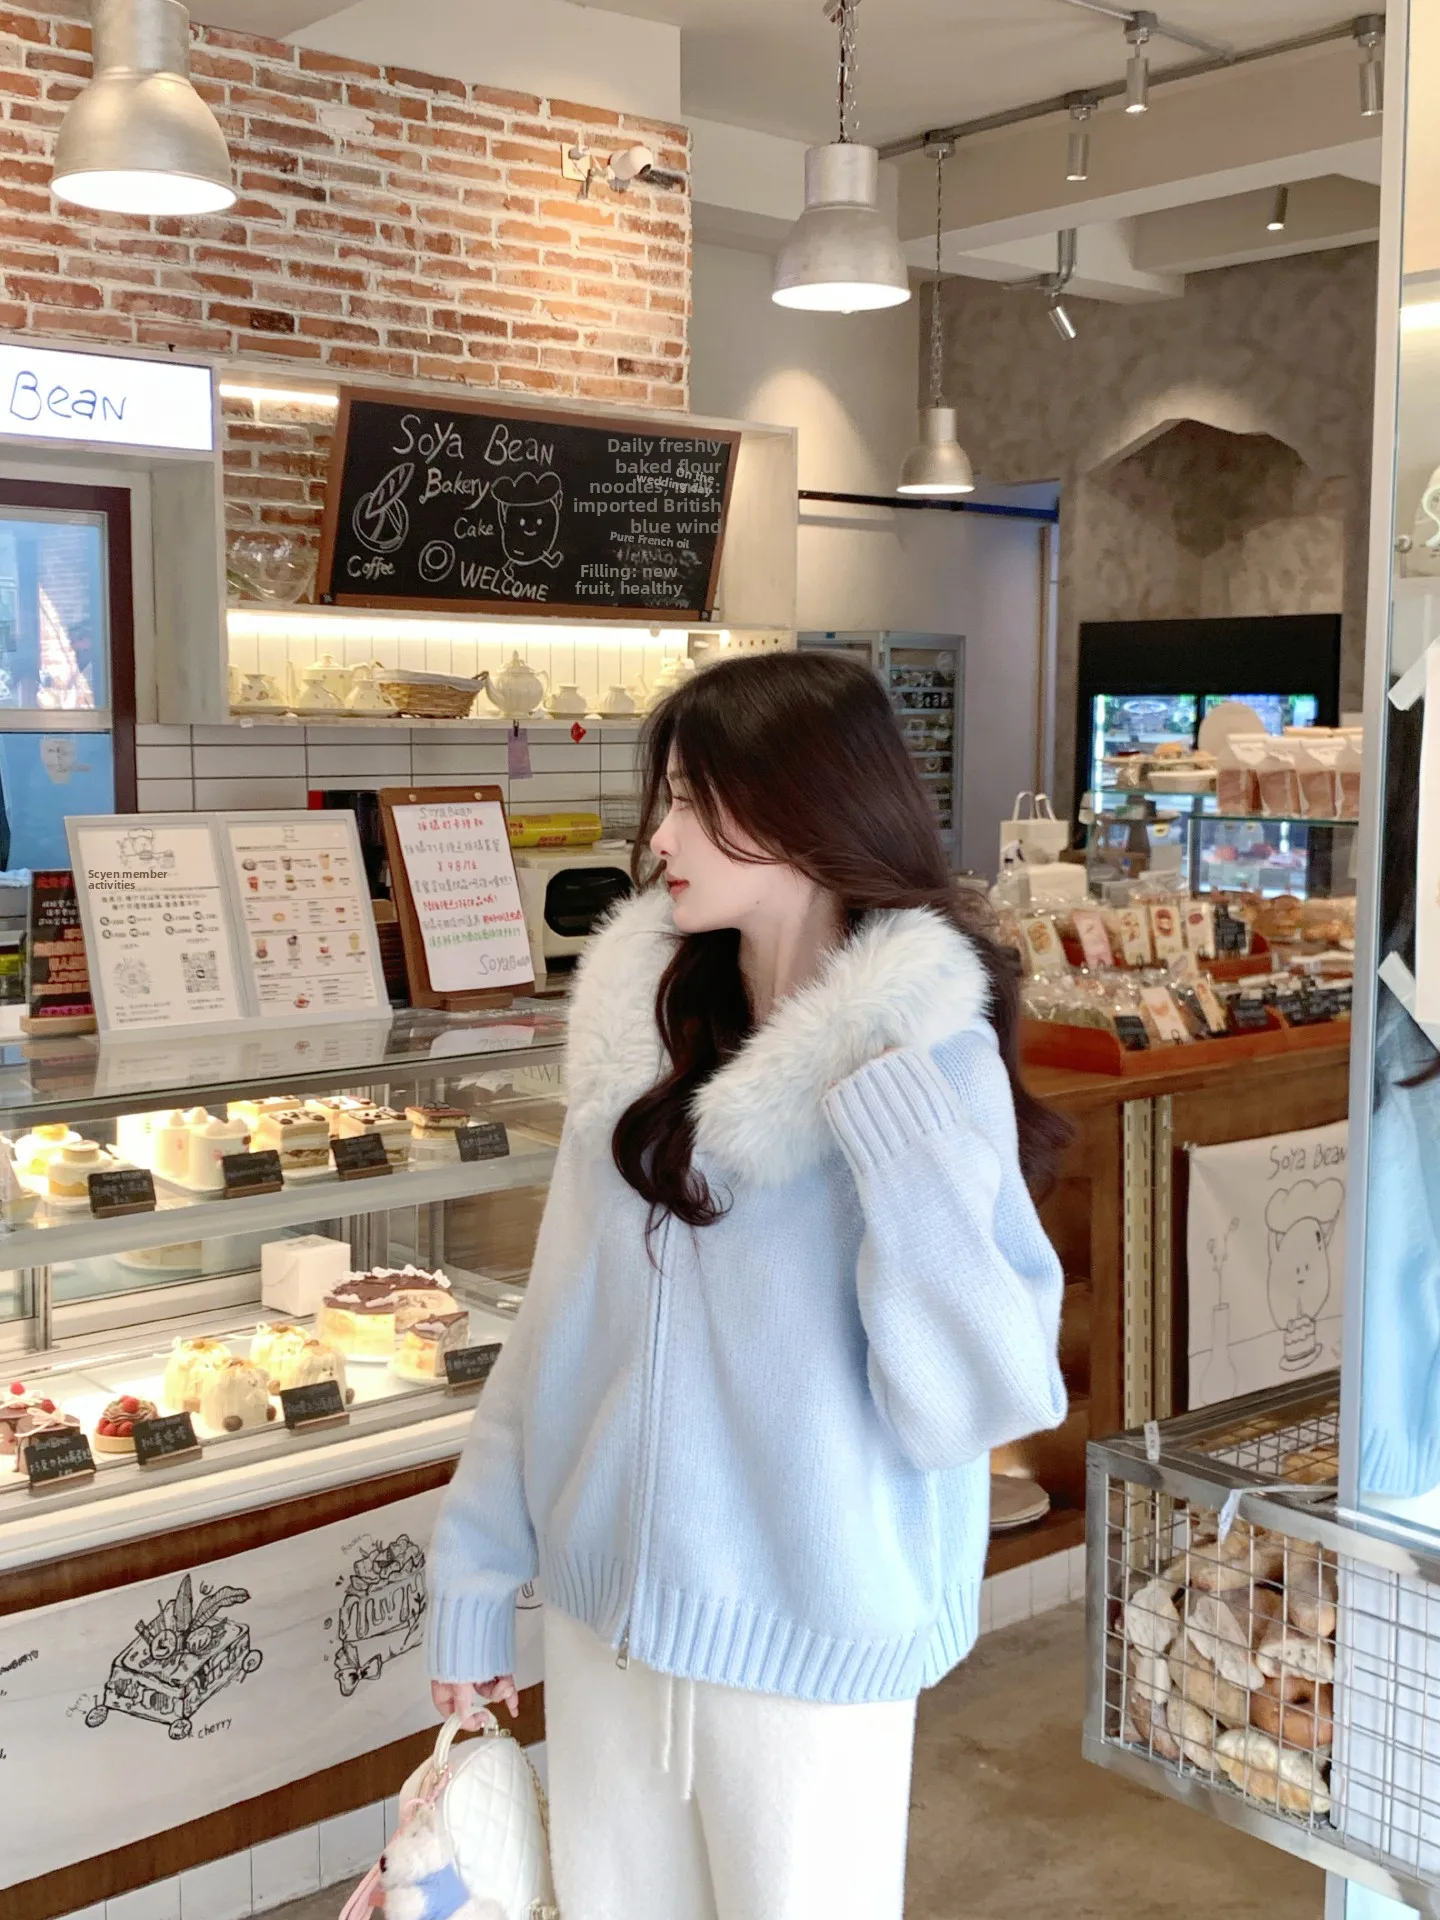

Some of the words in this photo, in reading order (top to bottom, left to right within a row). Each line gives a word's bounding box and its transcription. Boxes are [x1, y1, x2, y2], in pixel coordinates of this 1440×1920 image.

[419, 467, 490, 510] Bakery
[454, 517, 494, 539] Cake
[347, 555, 396, 579] Coffee
[460, 561, 550, 601] WELCOME
